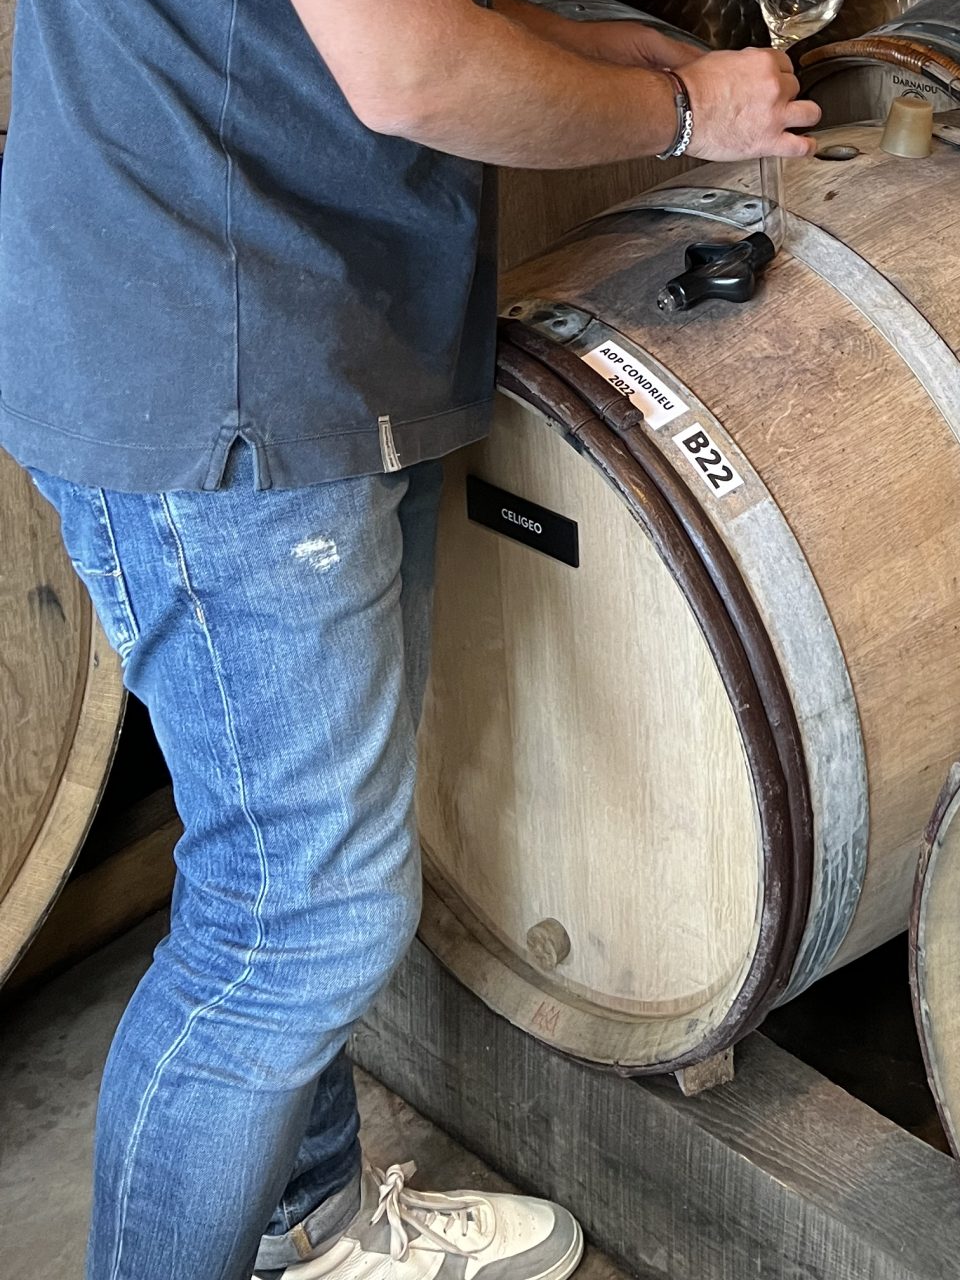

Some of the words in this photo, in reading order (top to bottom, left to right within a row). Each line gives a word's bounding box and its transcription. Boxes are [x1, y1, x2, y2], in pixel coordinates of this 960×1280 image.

[892, 75, 938, 95] DARNAJOU
[600, 348, 624, 365] AOP
[622, 364, 675, 411] CONDRIEU
[608, 375, 636, 397] 2022
[682, 430, 734, 490] B22
[501, 508, 542, 534] CELIGEO
